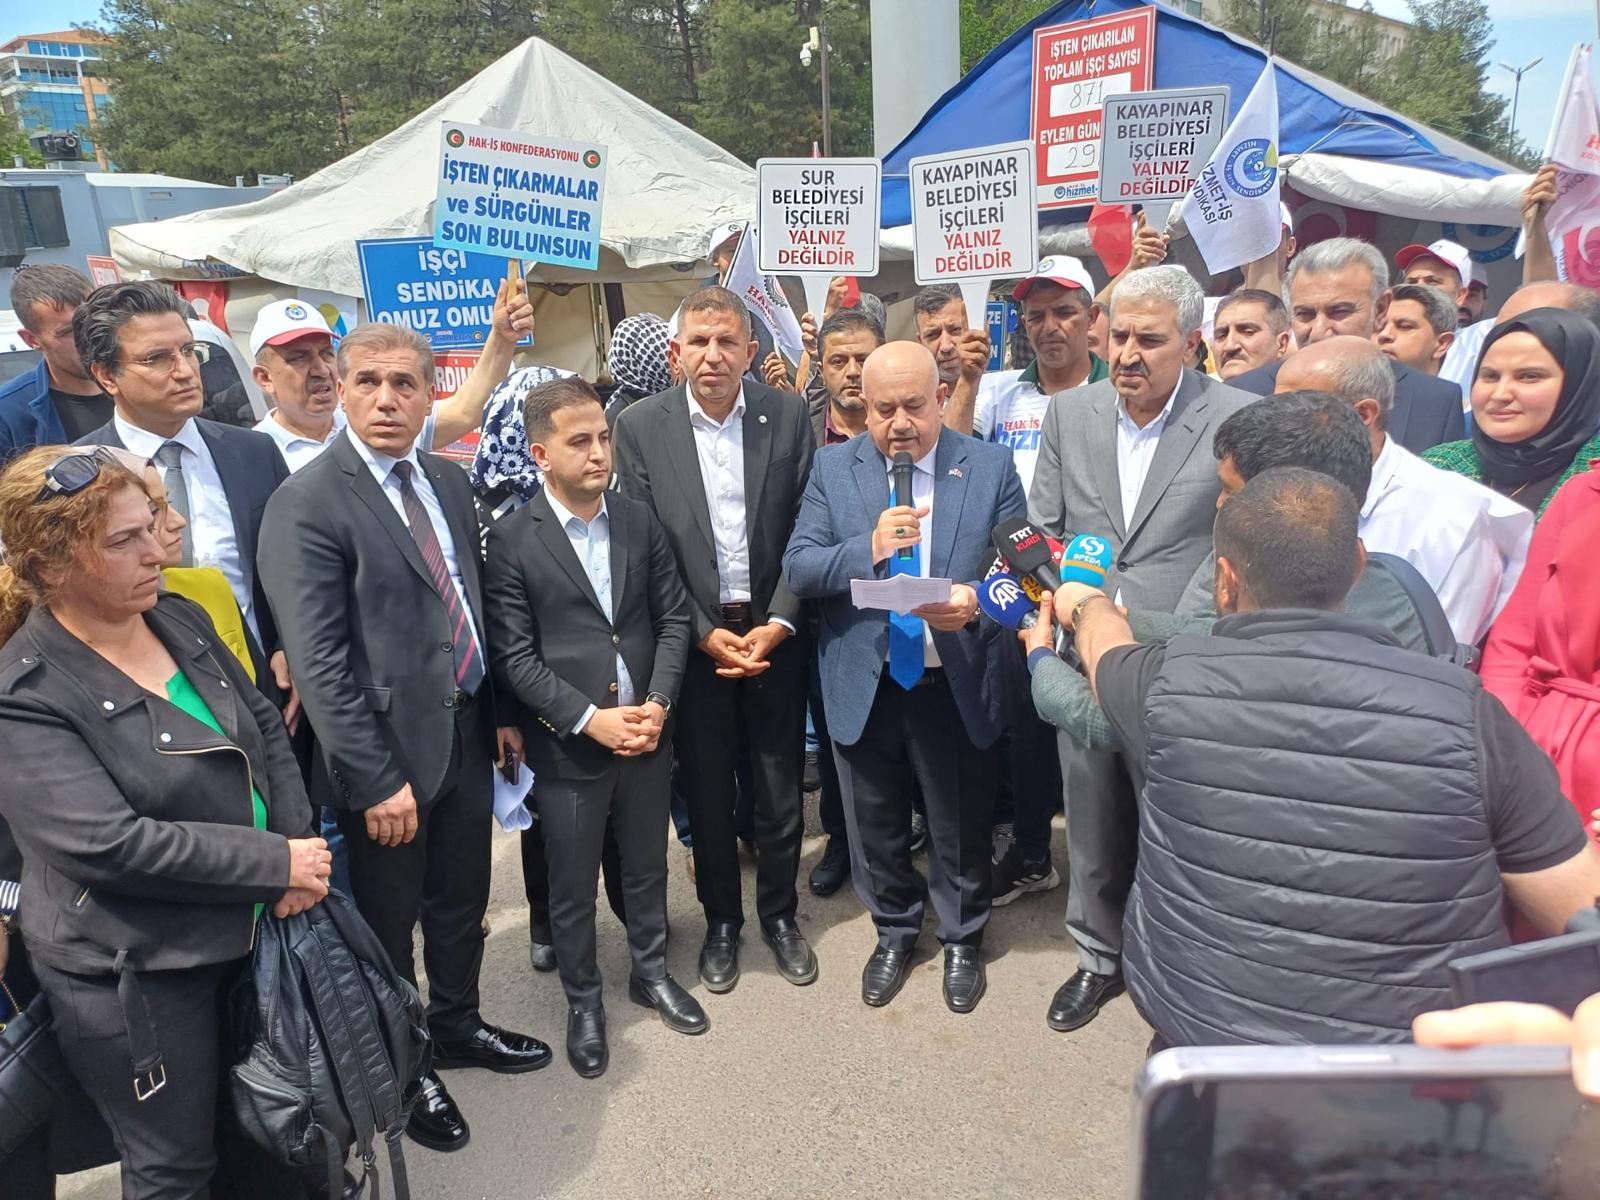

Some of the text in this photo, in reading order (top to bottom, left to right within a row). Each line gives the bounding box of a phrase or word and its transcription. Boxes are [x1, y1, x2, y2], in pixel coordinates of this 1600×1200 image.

[1081, 25, 1135, 56] ÇIKARILAN
[1044, 59, 1083, 81] TOPLAM
[1108, 48, 1141, 70] SAYISI
[1117, 100, 1213, 120] KAYAPINAR
[1040, 119, 1100, 145] EYLEM GÜN
[1117, 116, 1210, 139] BELEDİYESİ
[500, 141, 580, 162] KONFEDERASYONU
[1129, 137, 1195, 160] İŞÇİLERİ
[443, 153, 599, 201] İŞTEN ÇIKARMALAR
[801, 170, 835, 185] SUR
[923, 156, 1018, 186] KAYAPINAR
[1132, 160, 1190, 176] YALNIZ
[772, 186, 864, 205] BELEDİYESİ
[926, 175, 1017, 207] BELEDİYESİ
[1066, 184, 1097, 196] hizmet-
[1203, 161, 1233, 221] İZMET-İŞ
[447, 193, 591, 232] ve SÜRGÜNLER
[1193, 180, 1217, 224] NDİKASI
[785, 206, 850, 228] İŞÇİLERİ
[939, 201, 1004, 232] İŞÇİLERİ
[441, 220, 592, 261] SON BULUNSUN
[789, 230, 846, 245] YALNIZ
[944, 229, 1001, 250] YALNIZ
[778, 246, 855, 265] DEĞİLDİR
[936, 248, 1012, 273] DEĞİLDİR
[446, 305, 494, 327] OMU
[988, 311, 1001, 324] ZE
[990, 345, 998, 358] N
[1009, 526, 1033, 542] TRT
